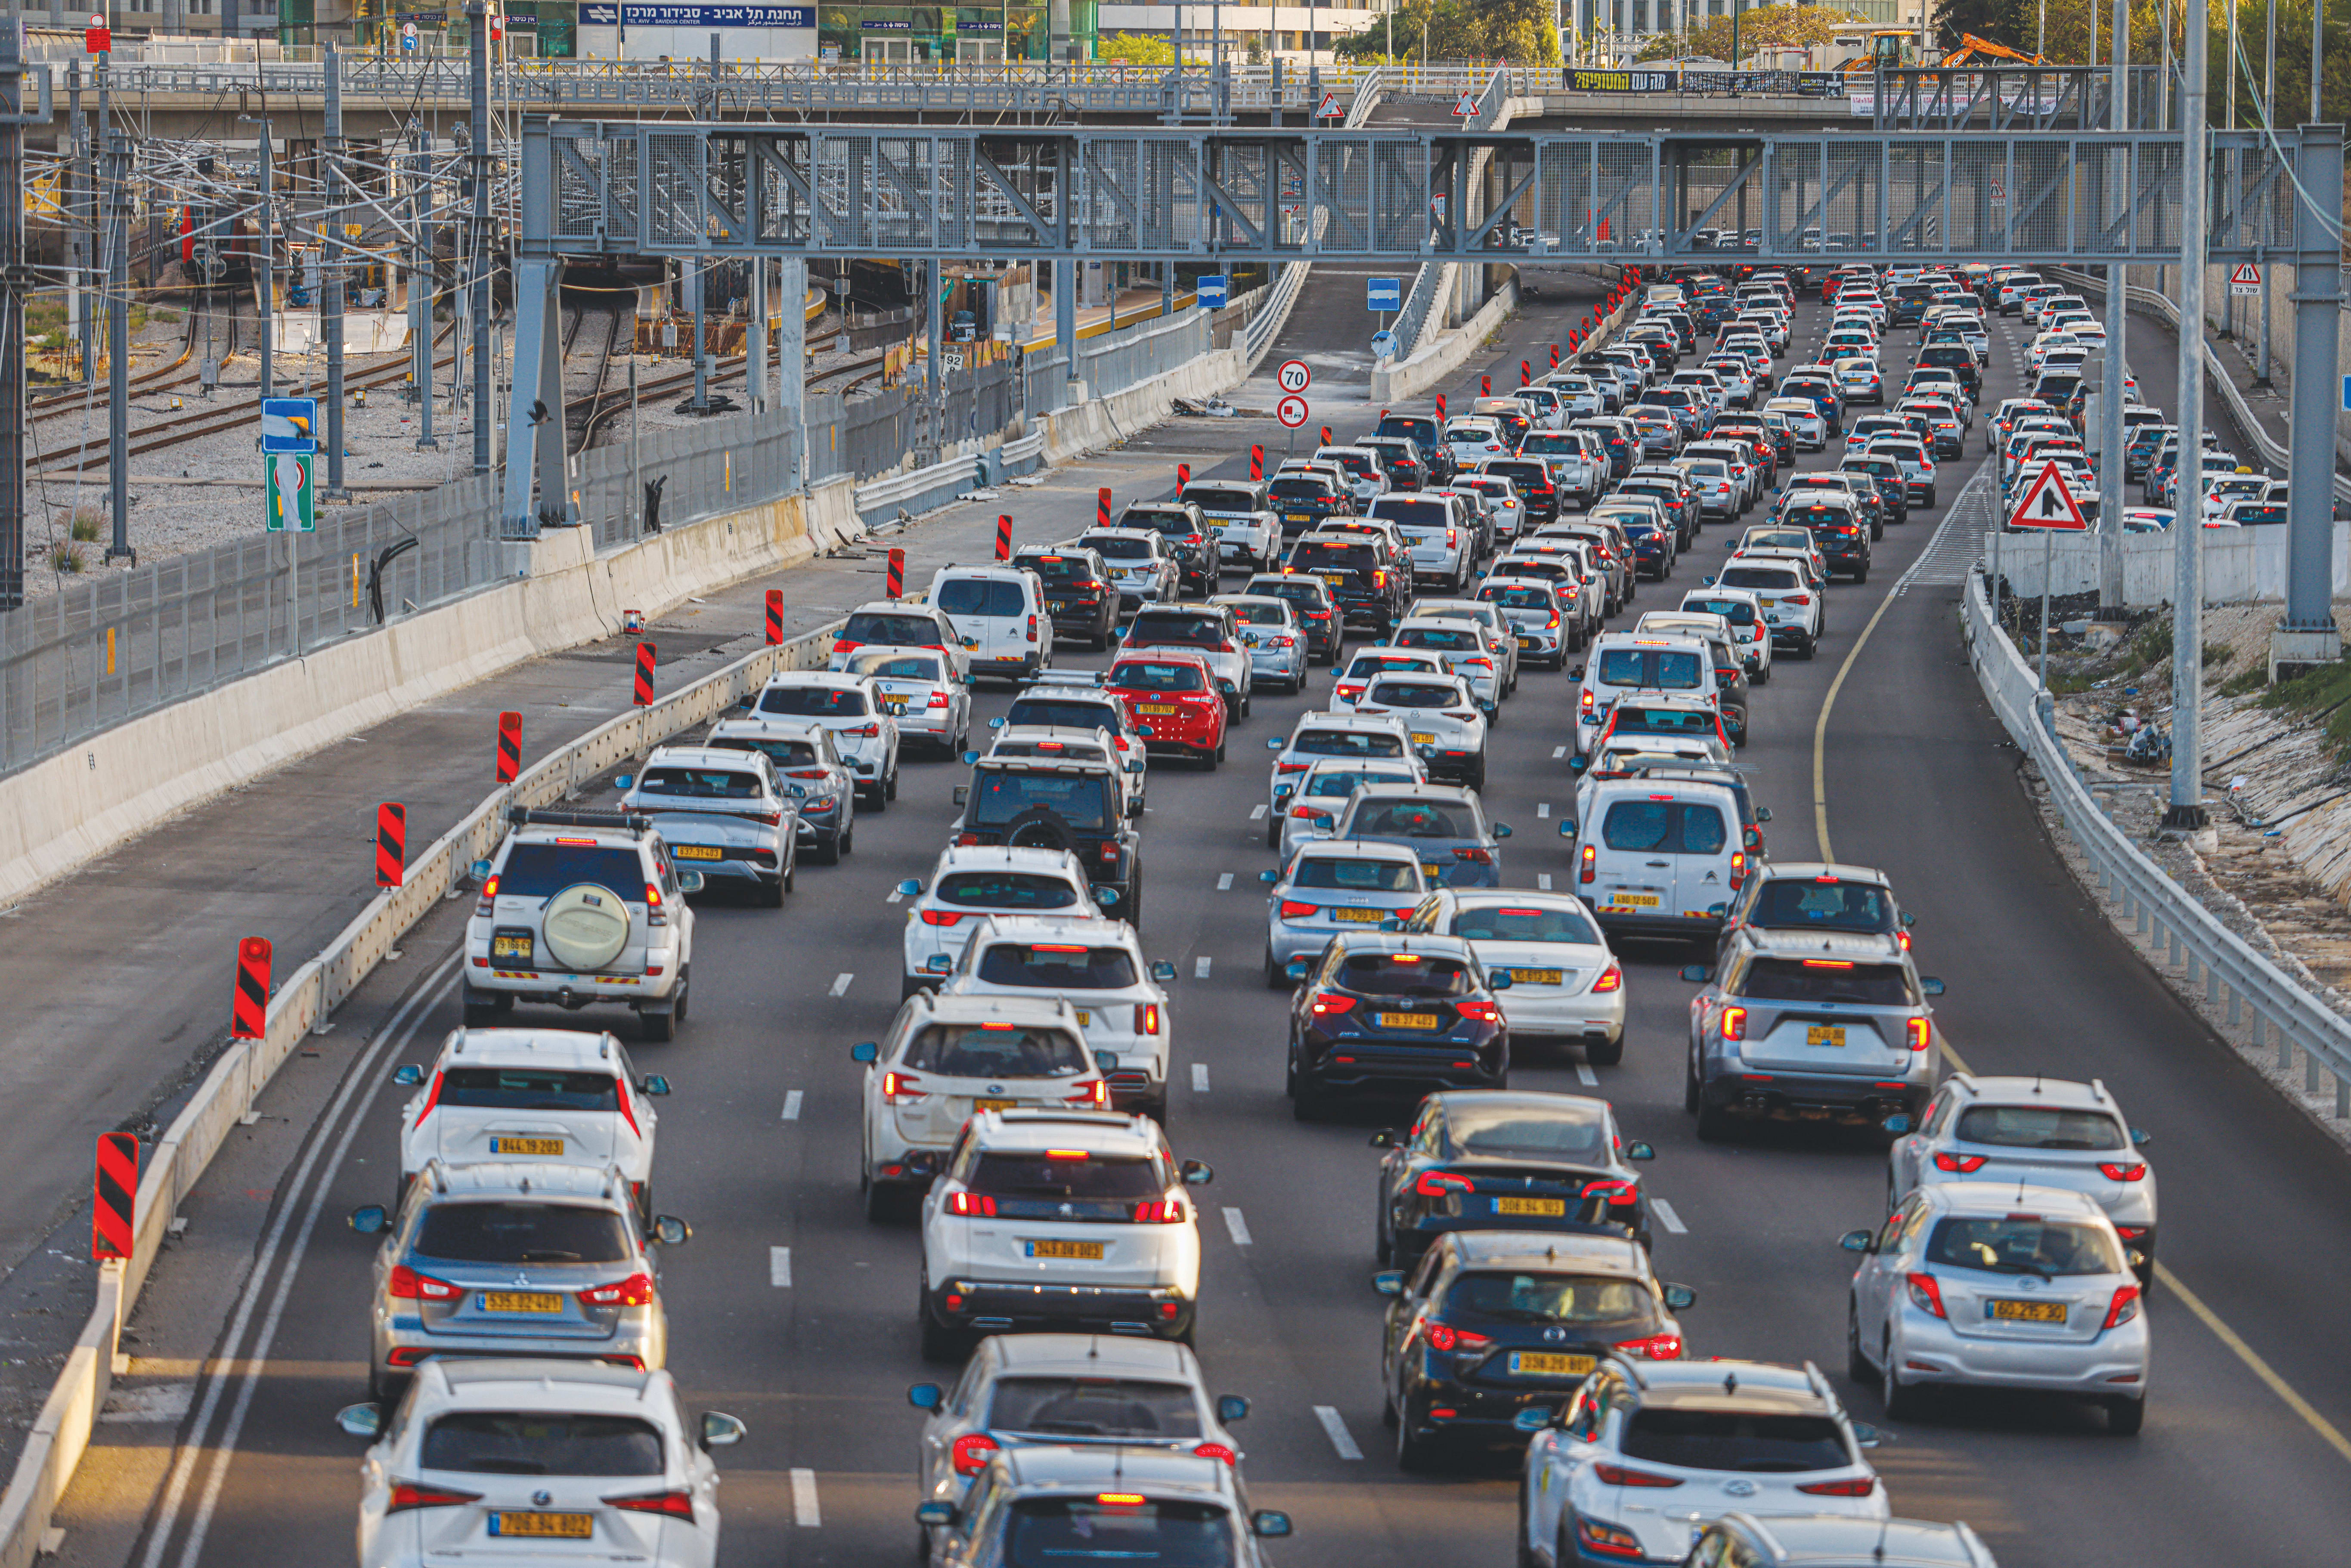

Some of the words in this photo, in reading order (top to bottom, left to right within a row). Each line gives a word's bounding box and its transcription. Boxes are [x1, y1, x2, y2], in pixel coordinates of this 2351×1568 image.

[626, 7, 657, 17] מרכז
[660, 8, 701, 18] סבידור
[713, 9, 743, 19] אביב
[746, 7, 764, 19] תל
[767, 9, 802, 20] תחנת
[1856, 61, 1868, 69] JCB
[1574, 71, 1629, 90] החטופים?
[1632, 73, 1648, 90] עם
[1650, 73, 1666, 90] מה
[947, 356, 960, 365] 92
[1286, 371, 1304, 386] 70
